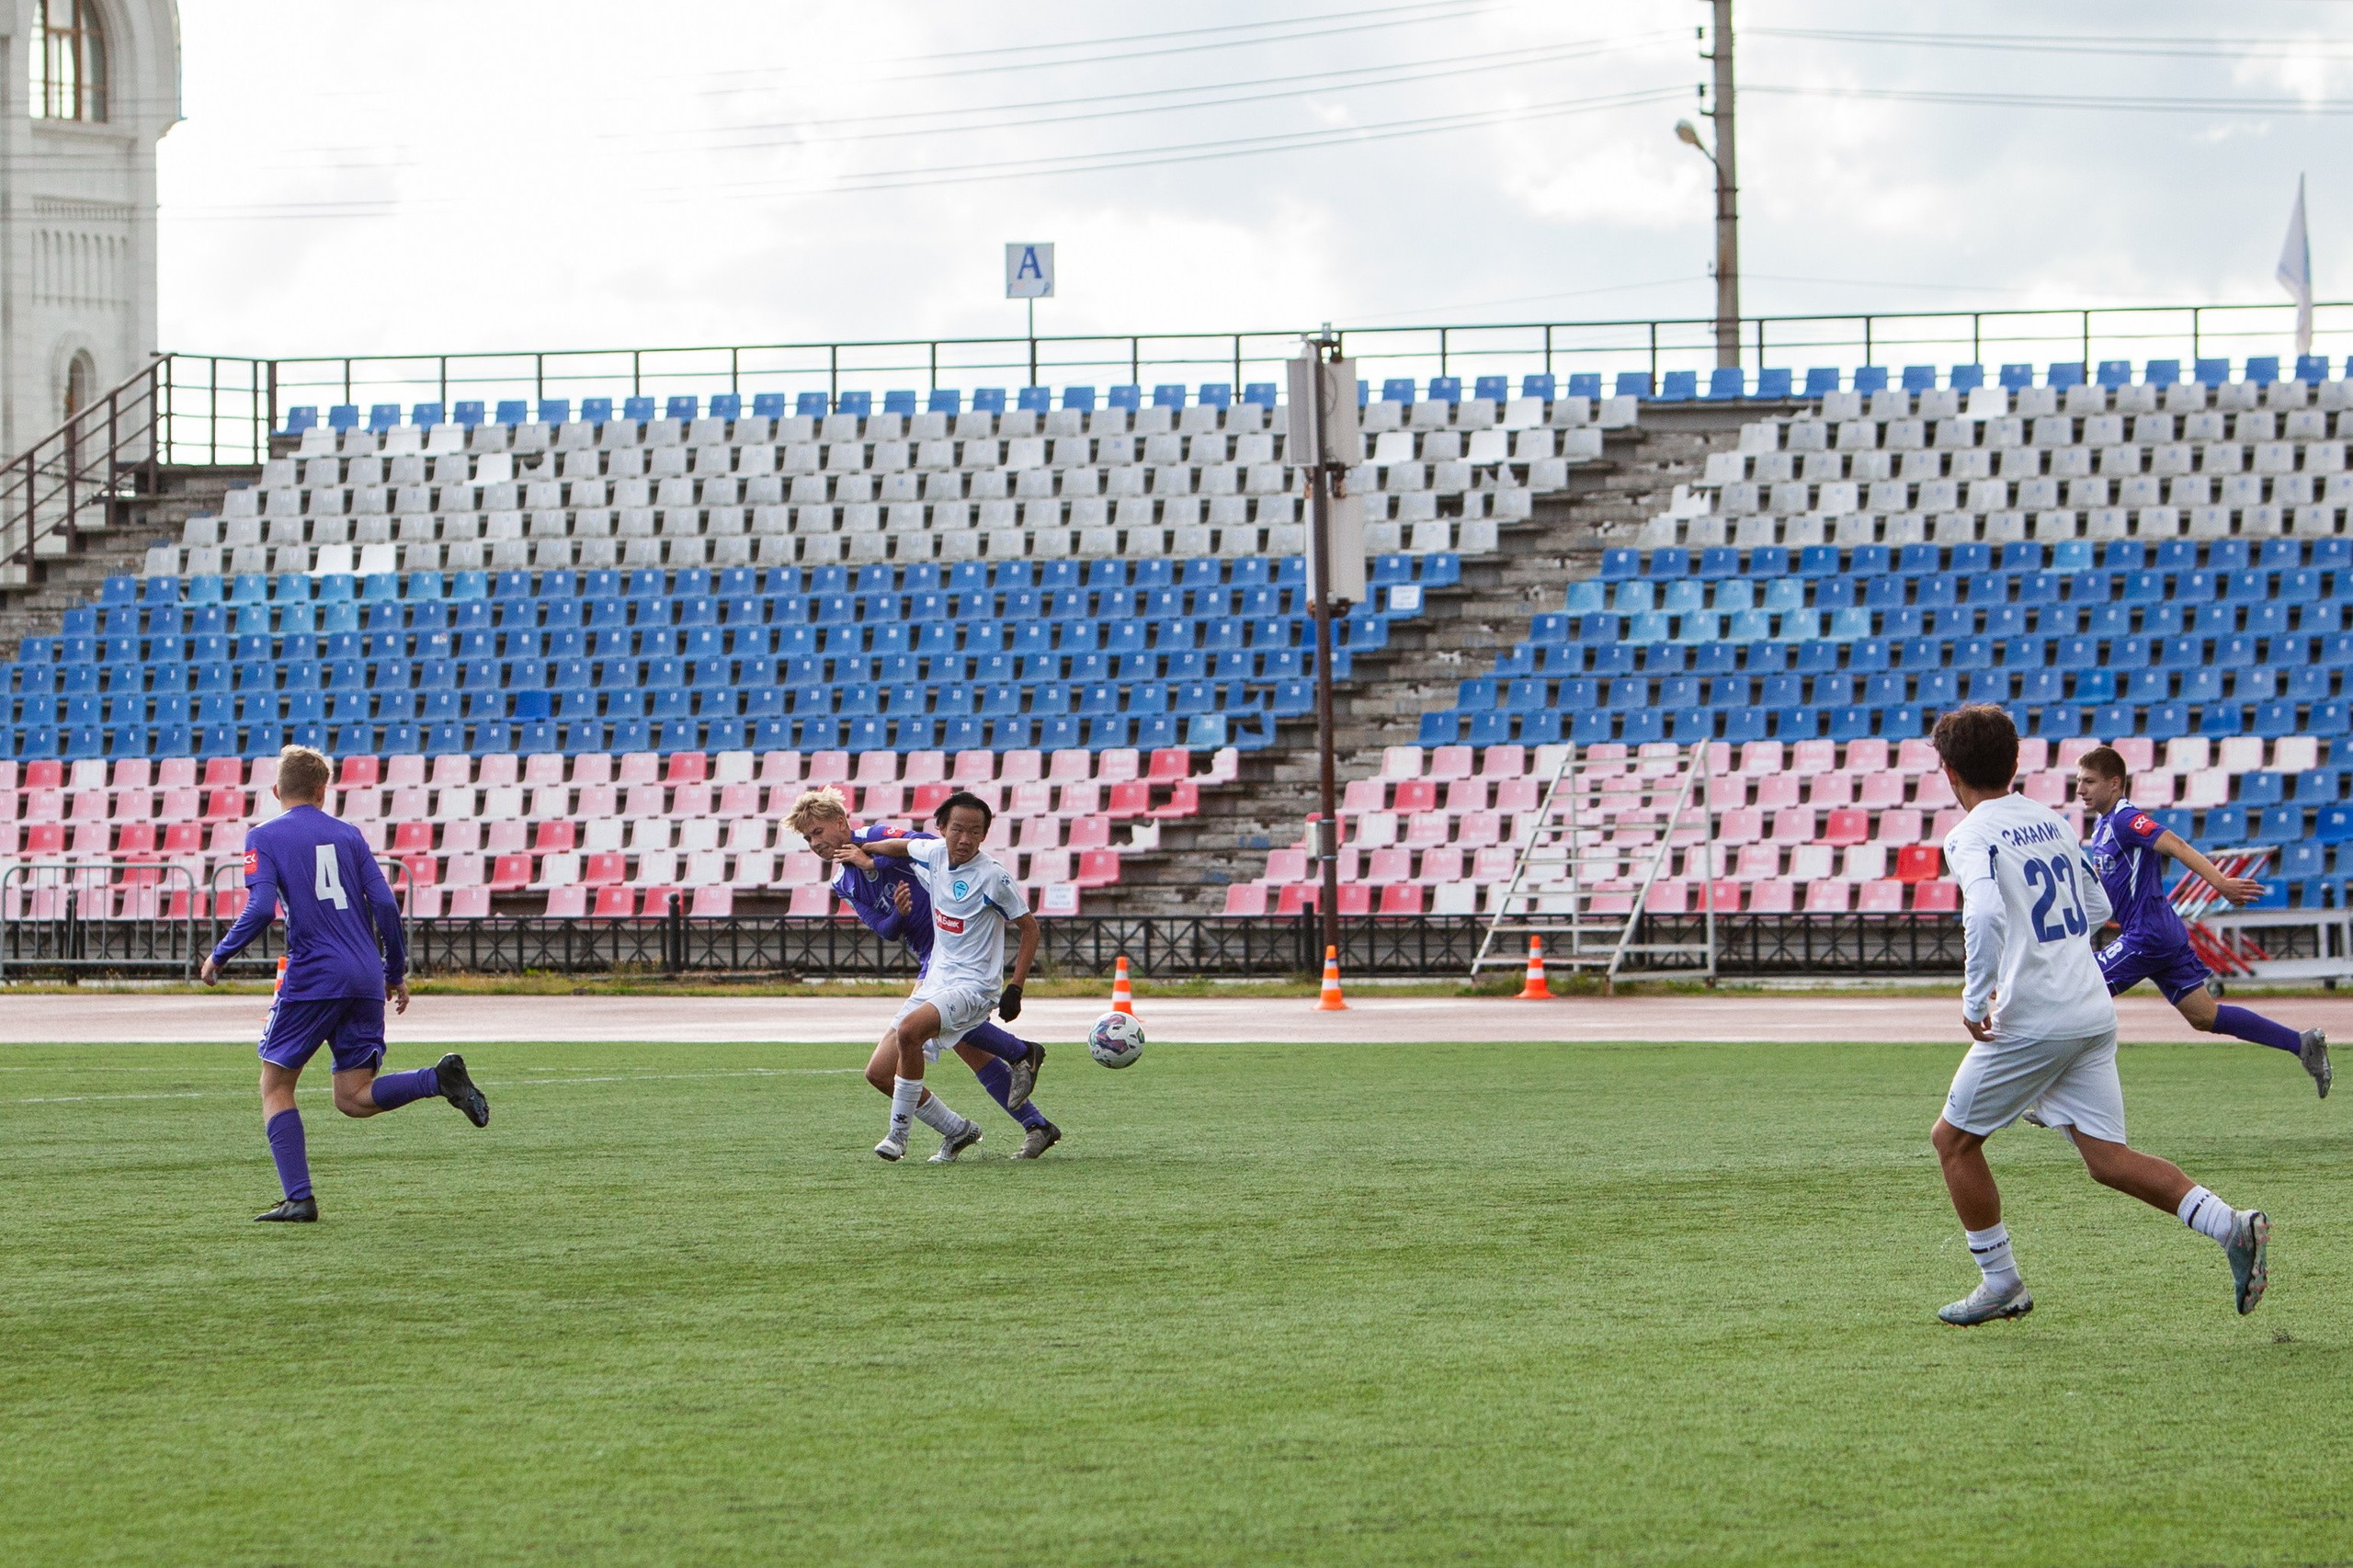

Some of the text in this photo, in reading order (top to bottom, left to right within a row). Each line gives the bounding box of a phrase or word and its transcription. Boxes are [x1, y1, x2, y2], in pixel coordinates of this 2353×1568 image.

[315, 843, 349, 911] 4
[2023, 853, 2088, 944] 23
[2105, 941, 2124, 960] 8
